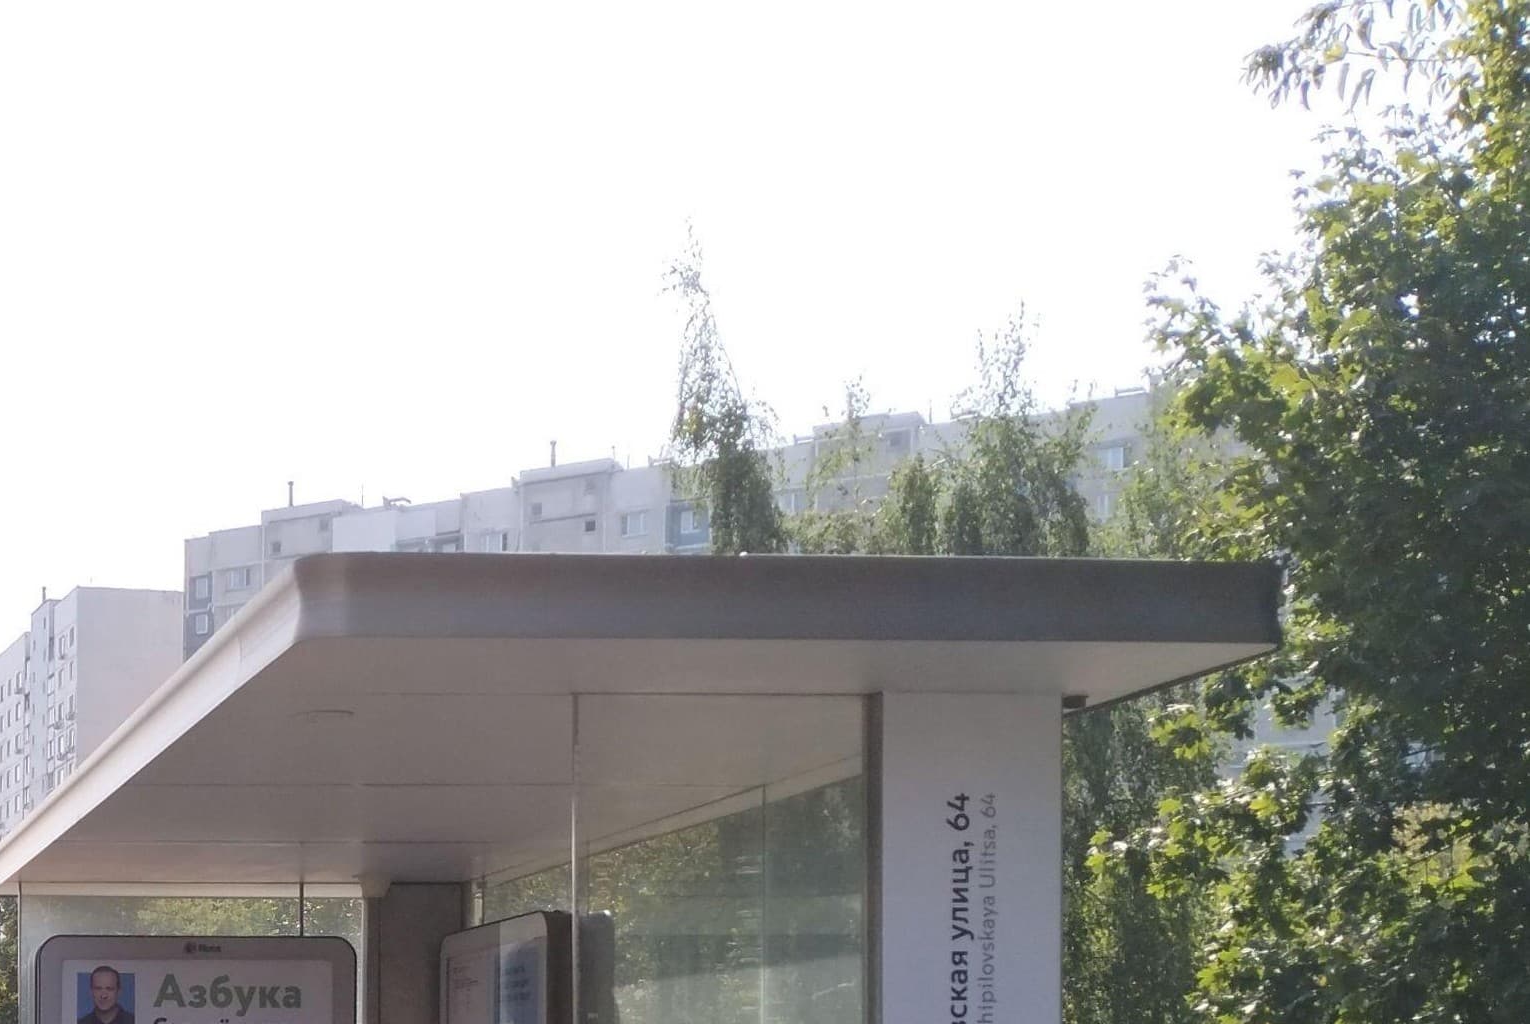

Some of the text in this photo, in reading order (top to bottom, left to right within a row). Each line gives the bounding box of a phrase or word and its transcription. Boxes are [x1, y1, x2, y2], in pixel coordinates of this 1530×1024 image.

[945, 792, 970, 831] 64
[981, 792, 997, 818] 64
[978, 824, 998, 889] Ulitsa,
[951, 840, 974, 941] улица,
[153, 972, 303, 1017] Азбука
